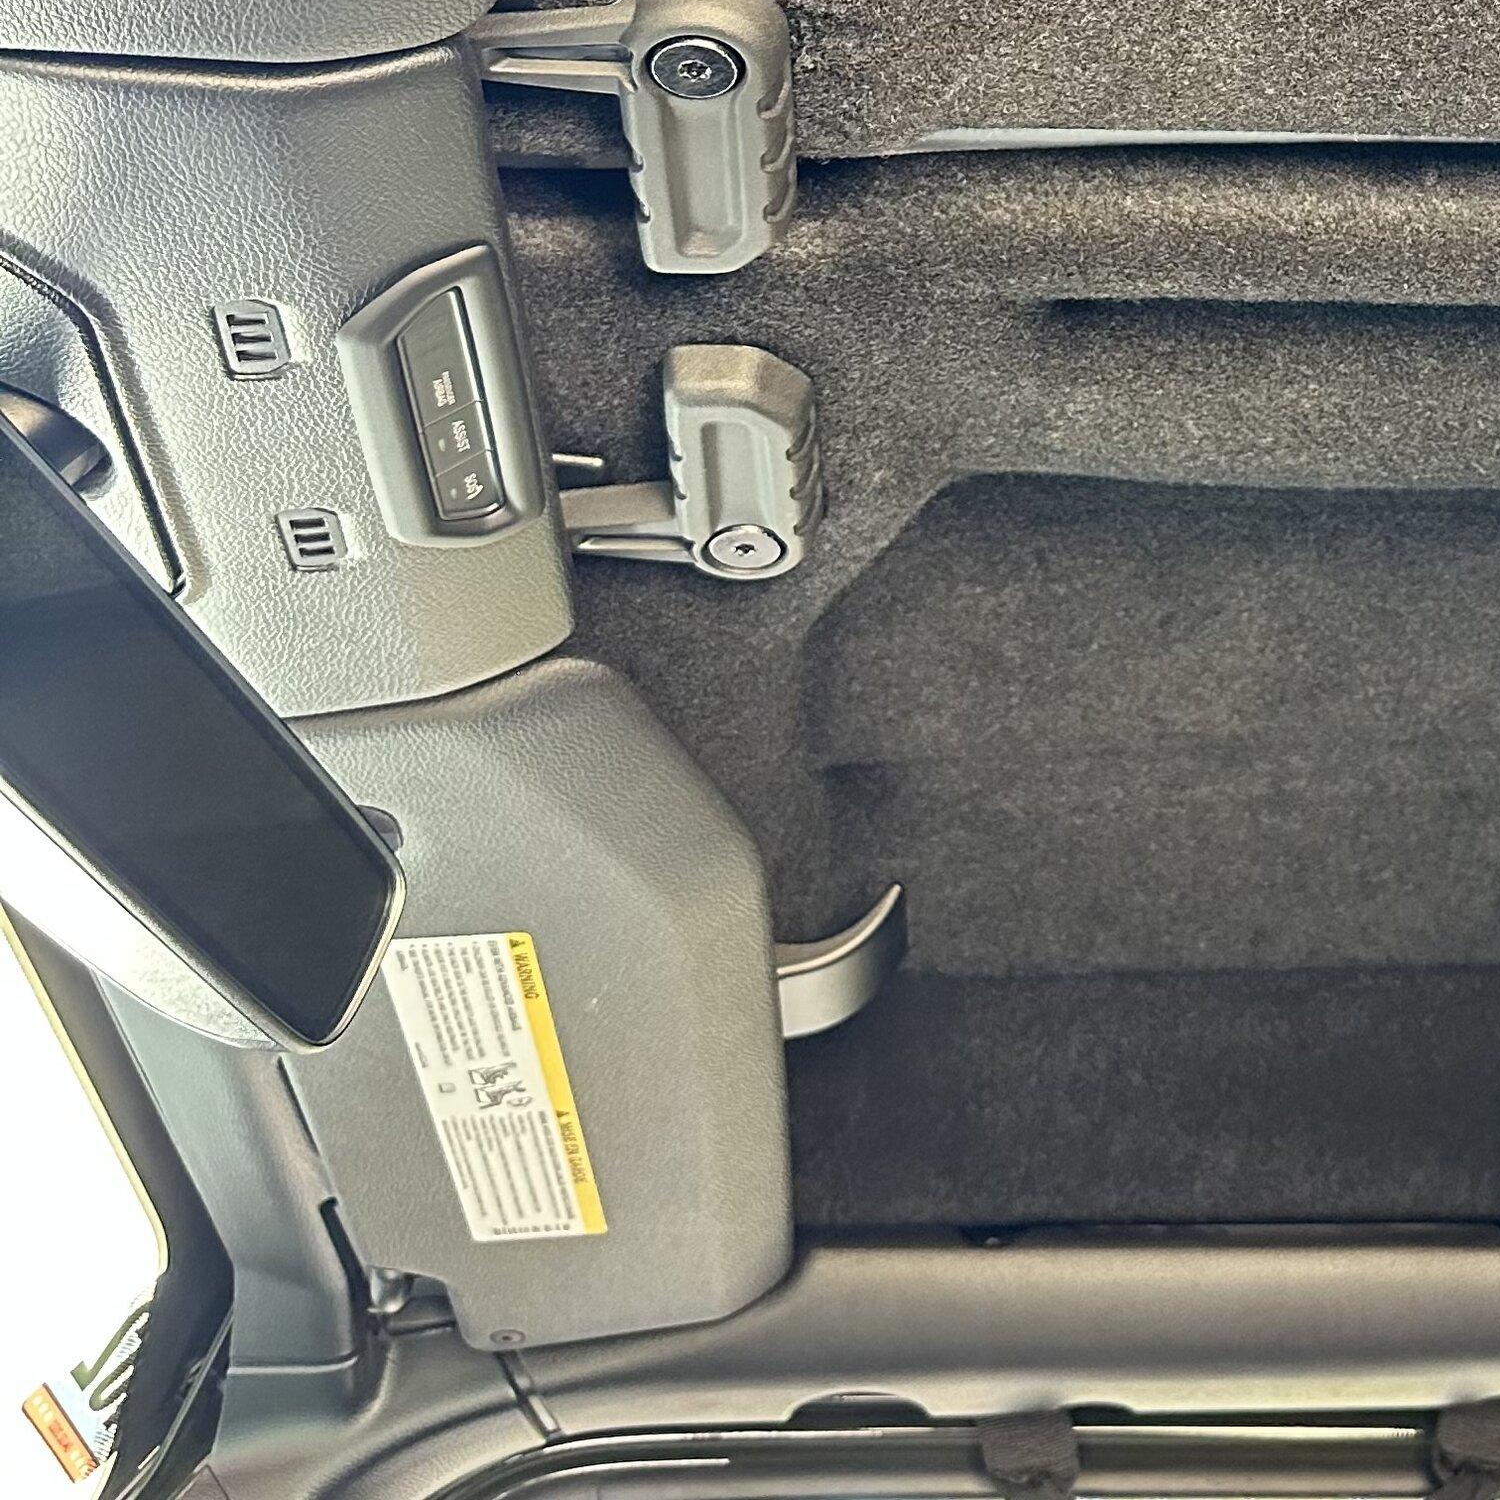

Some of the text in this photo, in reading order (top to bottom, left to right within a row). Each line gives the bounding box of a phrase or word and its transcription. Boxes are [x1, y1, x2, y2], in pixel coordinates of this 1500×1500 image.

[452, 420, 471, 453] ASSIST
[464, 473, 479, 494] SOS
[514, 953, 539, 1000] WARNING
